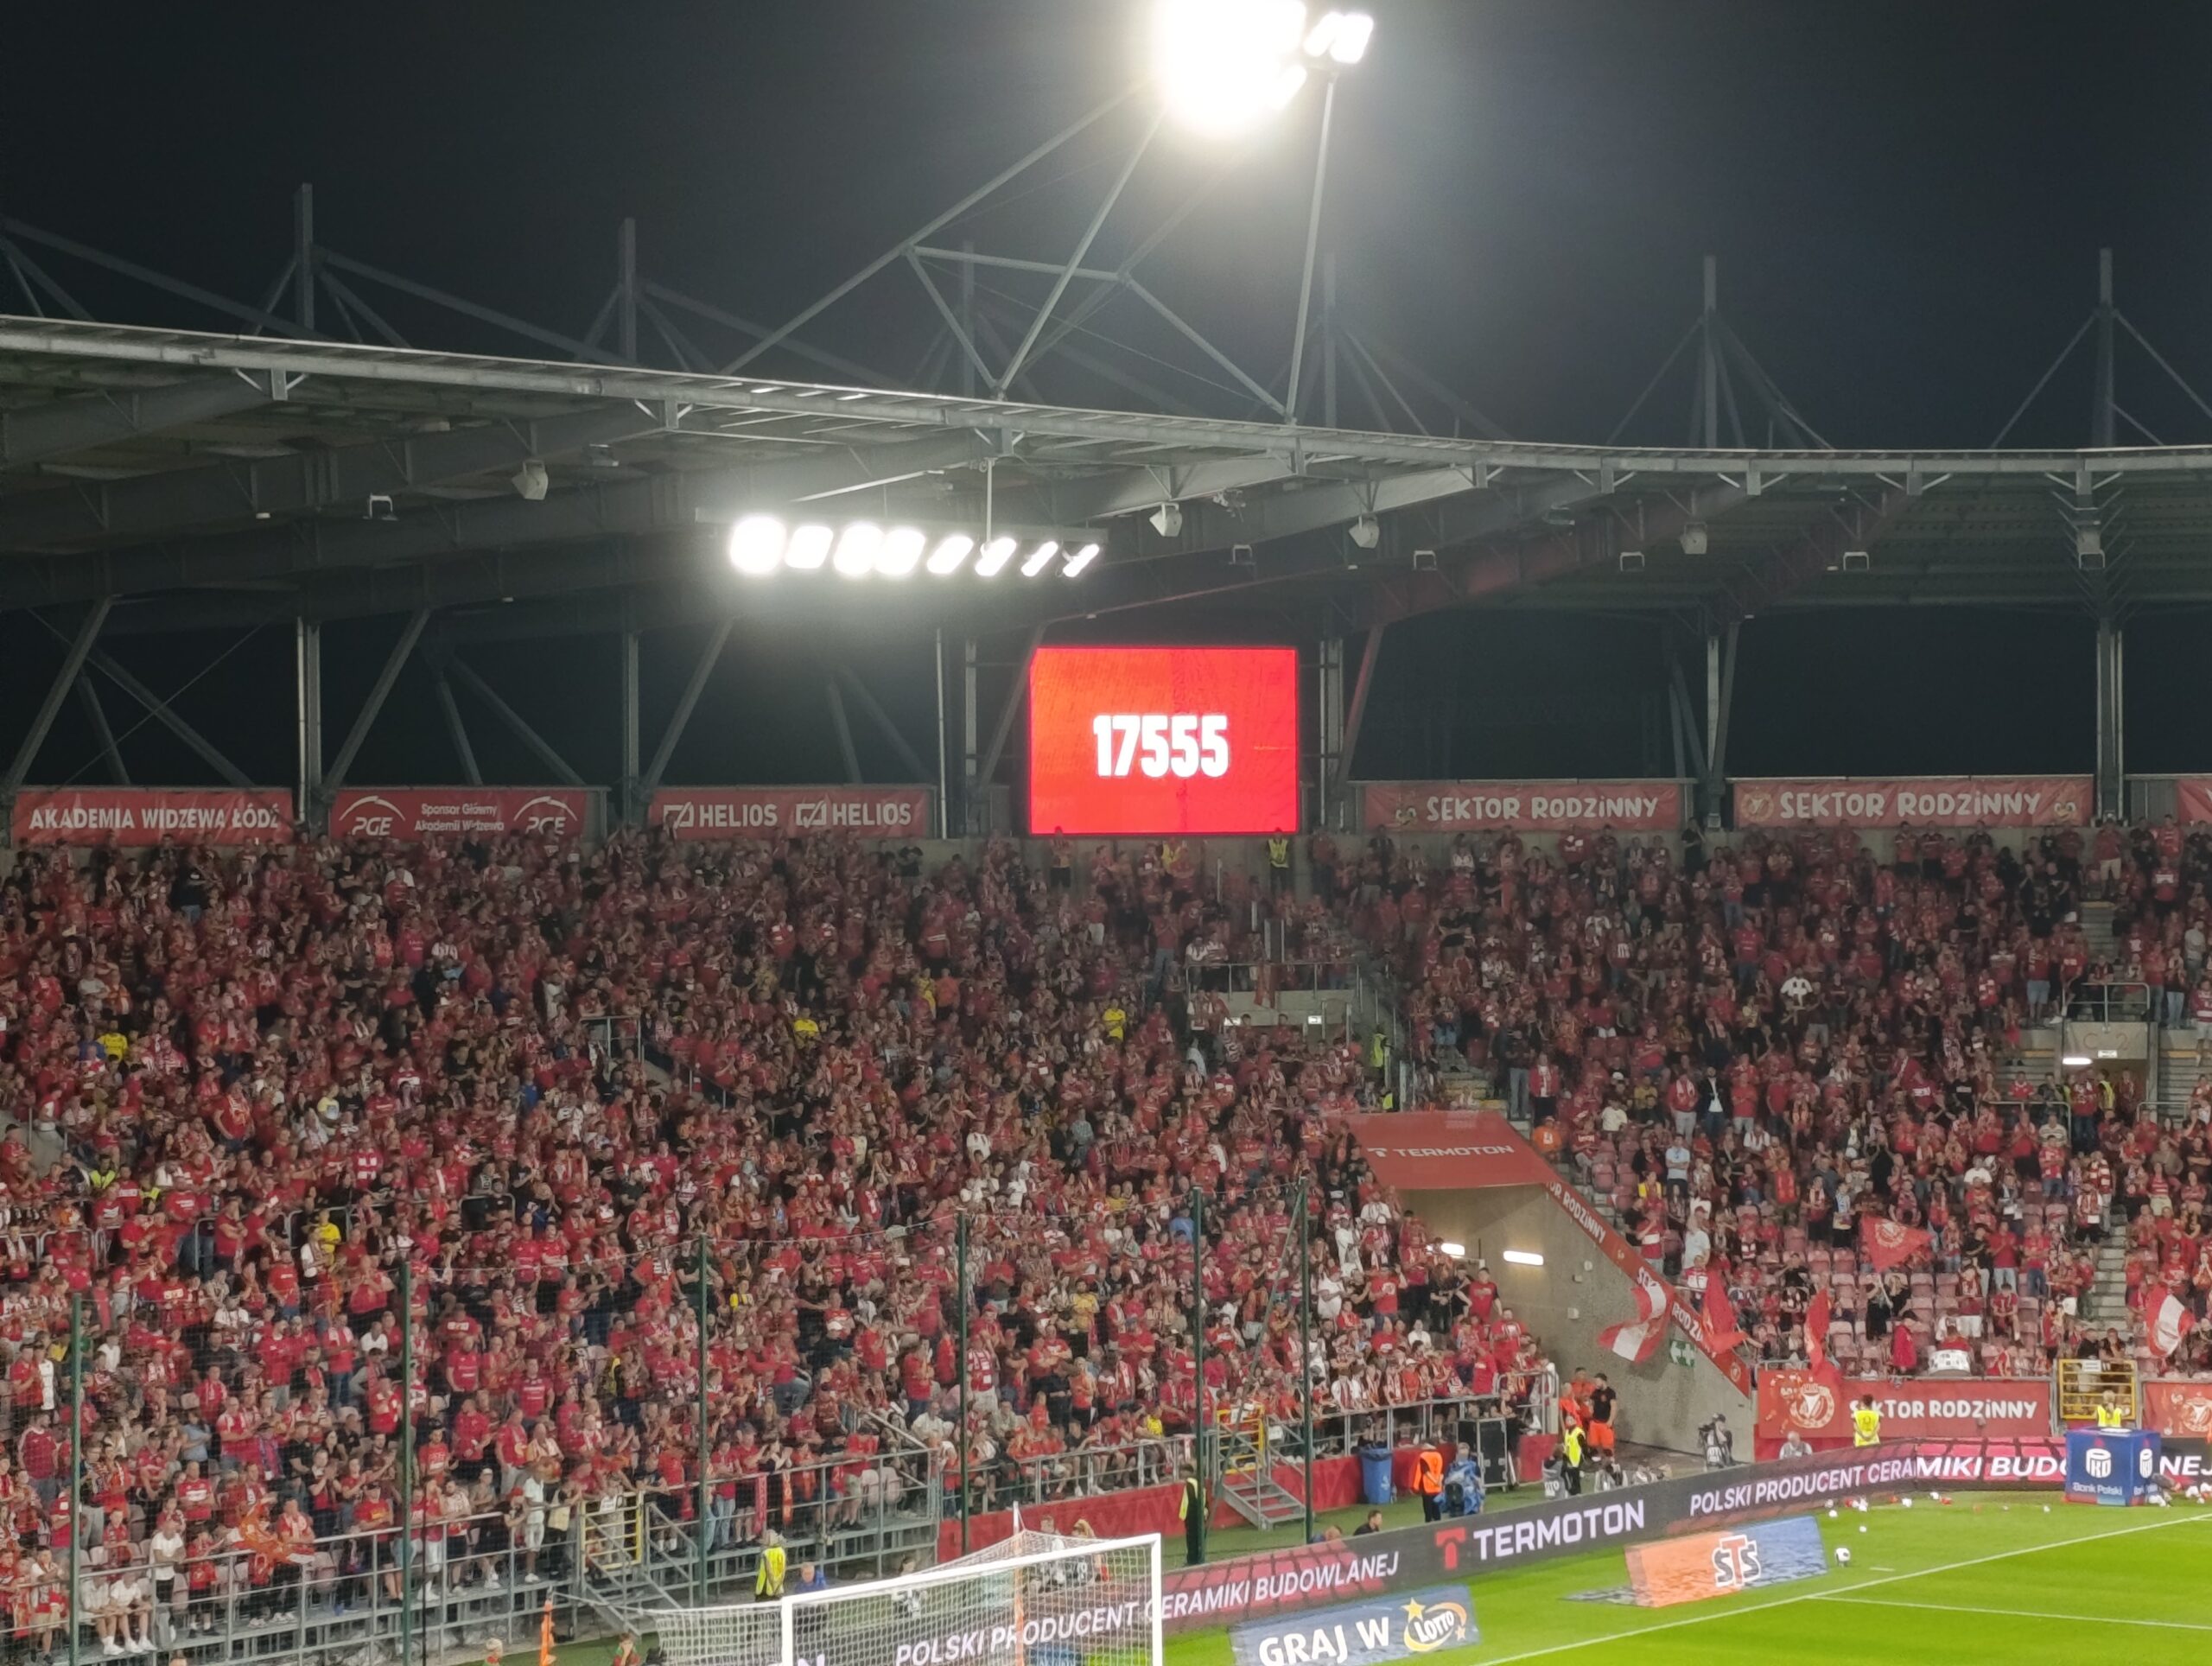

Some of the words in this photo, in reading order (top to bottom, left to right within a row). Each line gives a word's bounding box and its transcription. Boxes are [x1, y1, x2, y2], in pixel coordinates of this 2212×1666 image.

[1093, 715, 1230, 778] 17555
[421, 804, 460, 817] Sponsor
[699, 804, 778, 827] HELIOS
[833, 804, 911, 825] HELIOS
[1427, 796, 1520, 821] SEKTOR
[1780, 792, 1885, 818] SEKTOR
[29, 808, 136, 830] AKADEMIA
[142, 808, 226, 830] WIDZEWA
[352, 817, 392, 836] PGE
[1393, 1145, 1515, 1157] TERMOTON
[1849, 1399, 1925, 1419] SKTOR
[1690, 1485, 1751, 1517] POLSKI
[1755, 1466, 1864, 1504] PRODUCENT
[1990, 1456, 2067, 1478] BUD
[1473, 1500, 1644, 1561] TERMOTON
[1712, 1534, 1762, 1588] STS
[895, 1631, 984, 1666] POLSKI
[1255, 1551, 1399, 1600] BUDOWLANEJ
[1259, 1625, 1348, 1666] GRAJ
[1356, 1617, 1389, 1650] W
[1414, 1611, 1455, 1643] LOTTO
